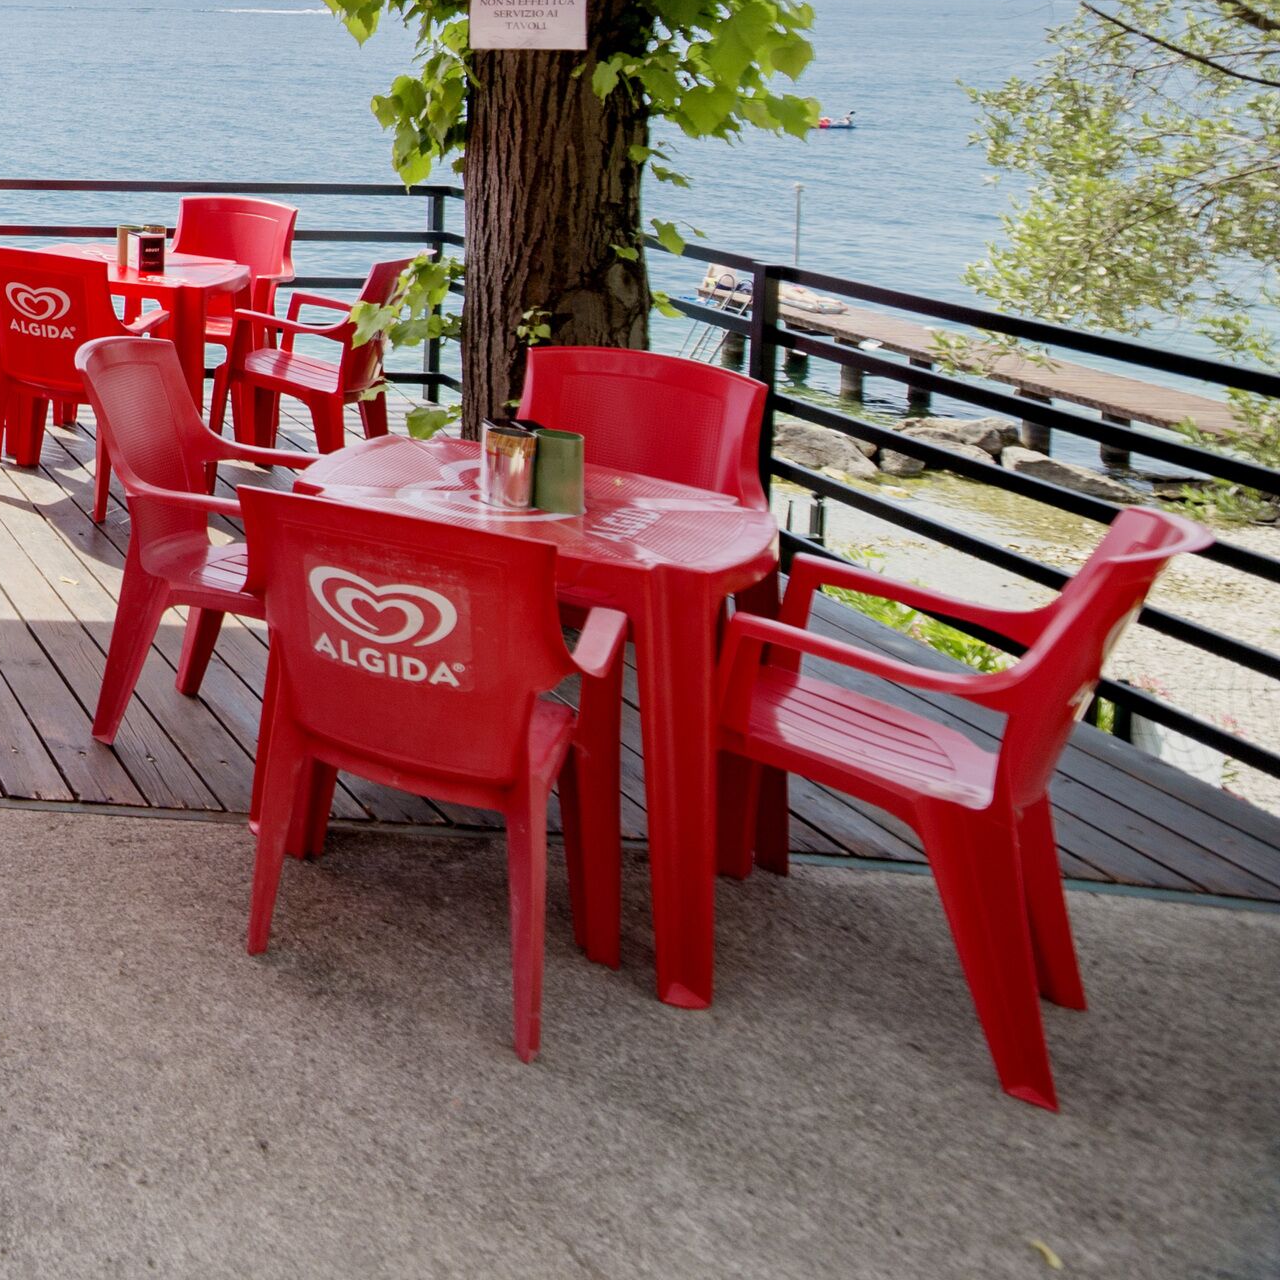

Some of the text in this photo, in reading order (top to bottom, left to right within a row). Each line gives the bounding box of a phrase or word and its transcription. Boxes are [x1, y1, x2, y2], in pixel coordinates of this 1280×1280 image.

[494, 10, 558, 18] SERVIZIO AI
[506, 22, 546, 30] TAVOLI
[10, 319, 75, 339] ALGIDA
[314, 632, 461, 687] ALGIDA
